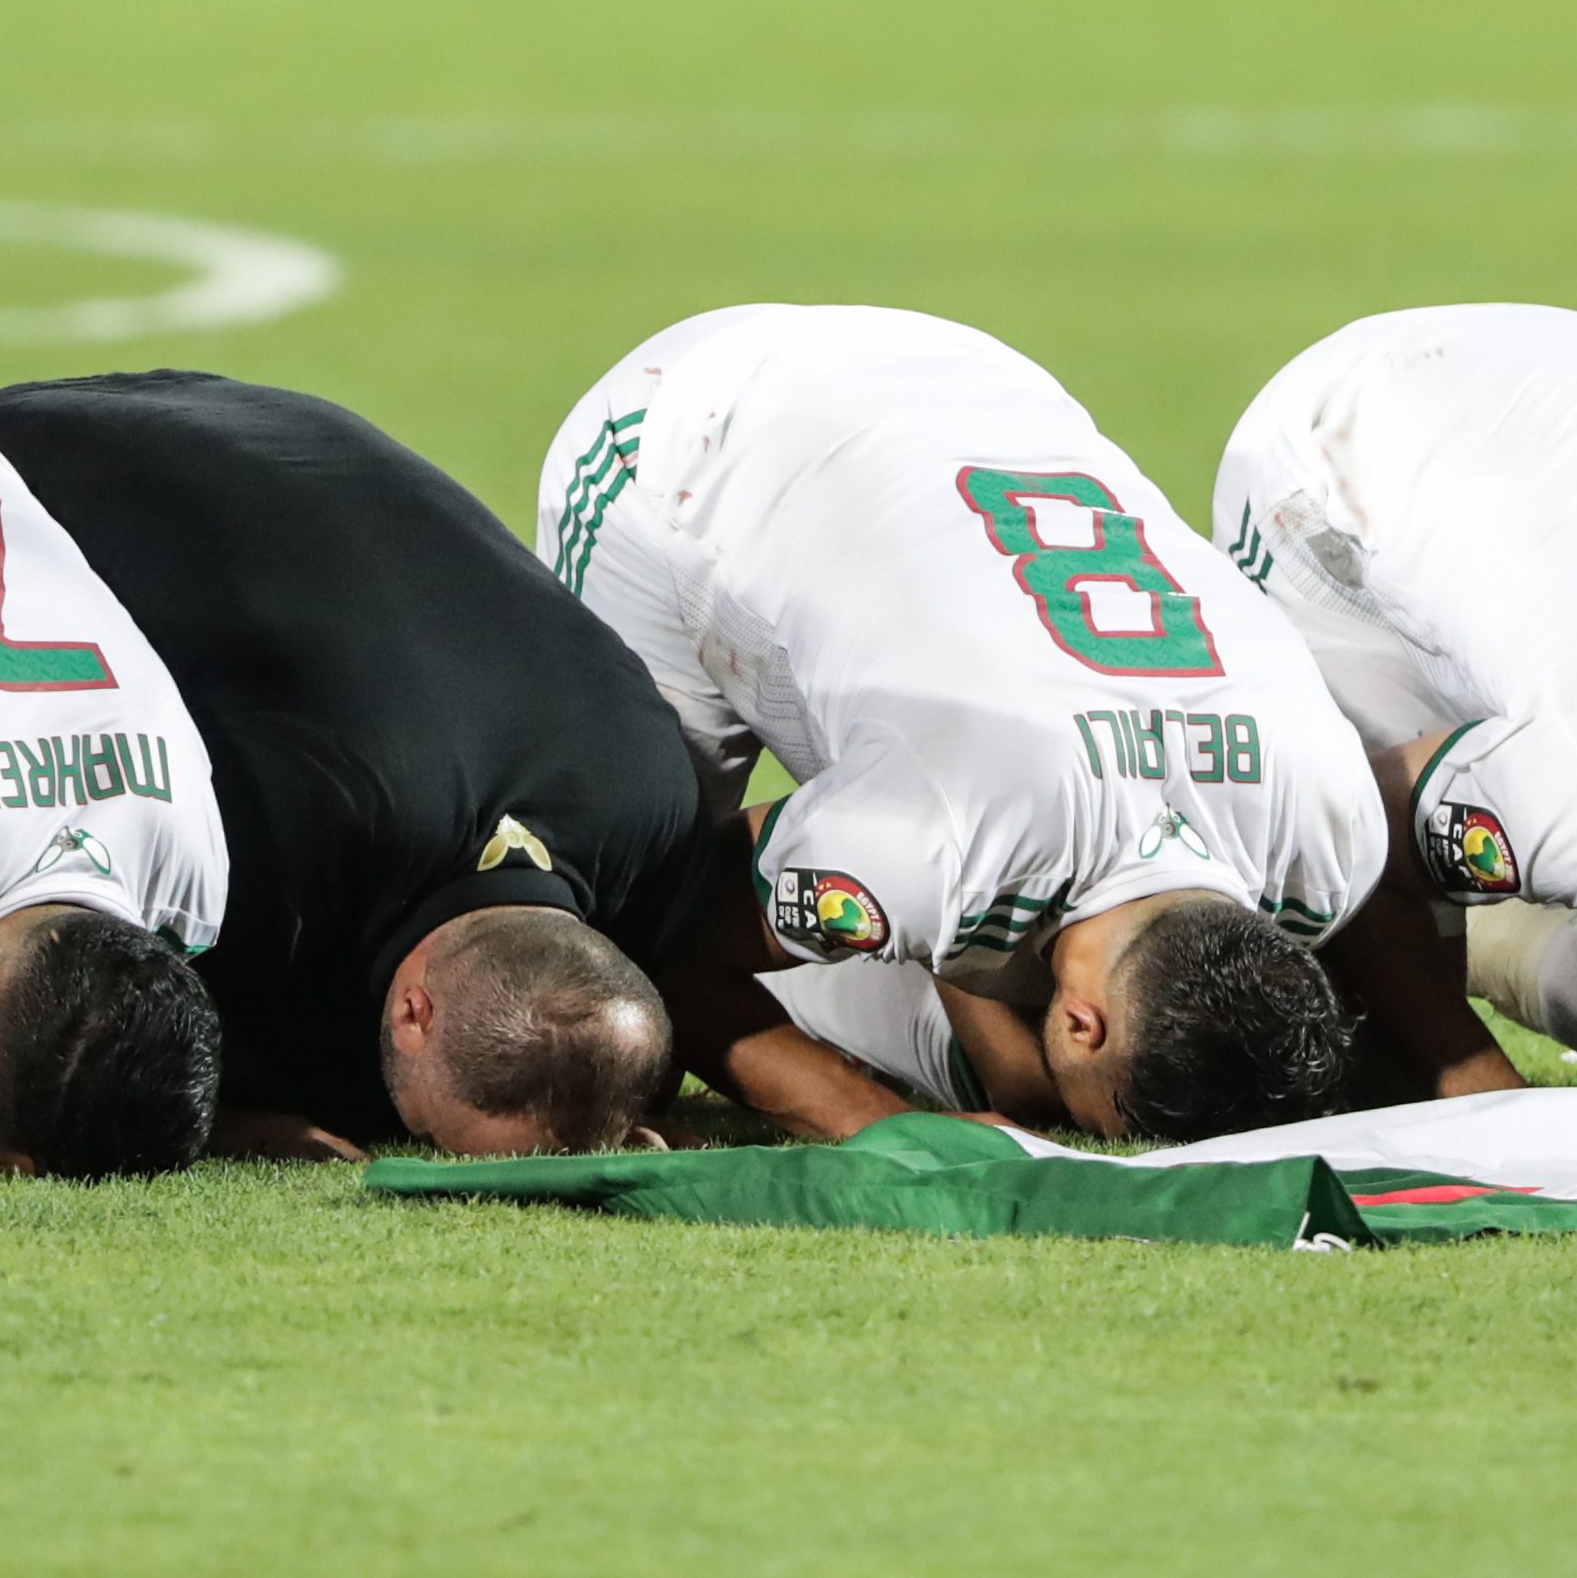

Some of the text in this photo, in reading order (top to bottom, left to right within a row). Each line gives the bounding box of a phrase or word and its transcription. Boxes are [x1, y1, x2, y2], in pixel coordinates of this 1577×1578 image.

[955, 465, 1226, 677] 8
[1453, 823, 1472, 878] CAF
[856, 892, 881, 919] EGYPT
